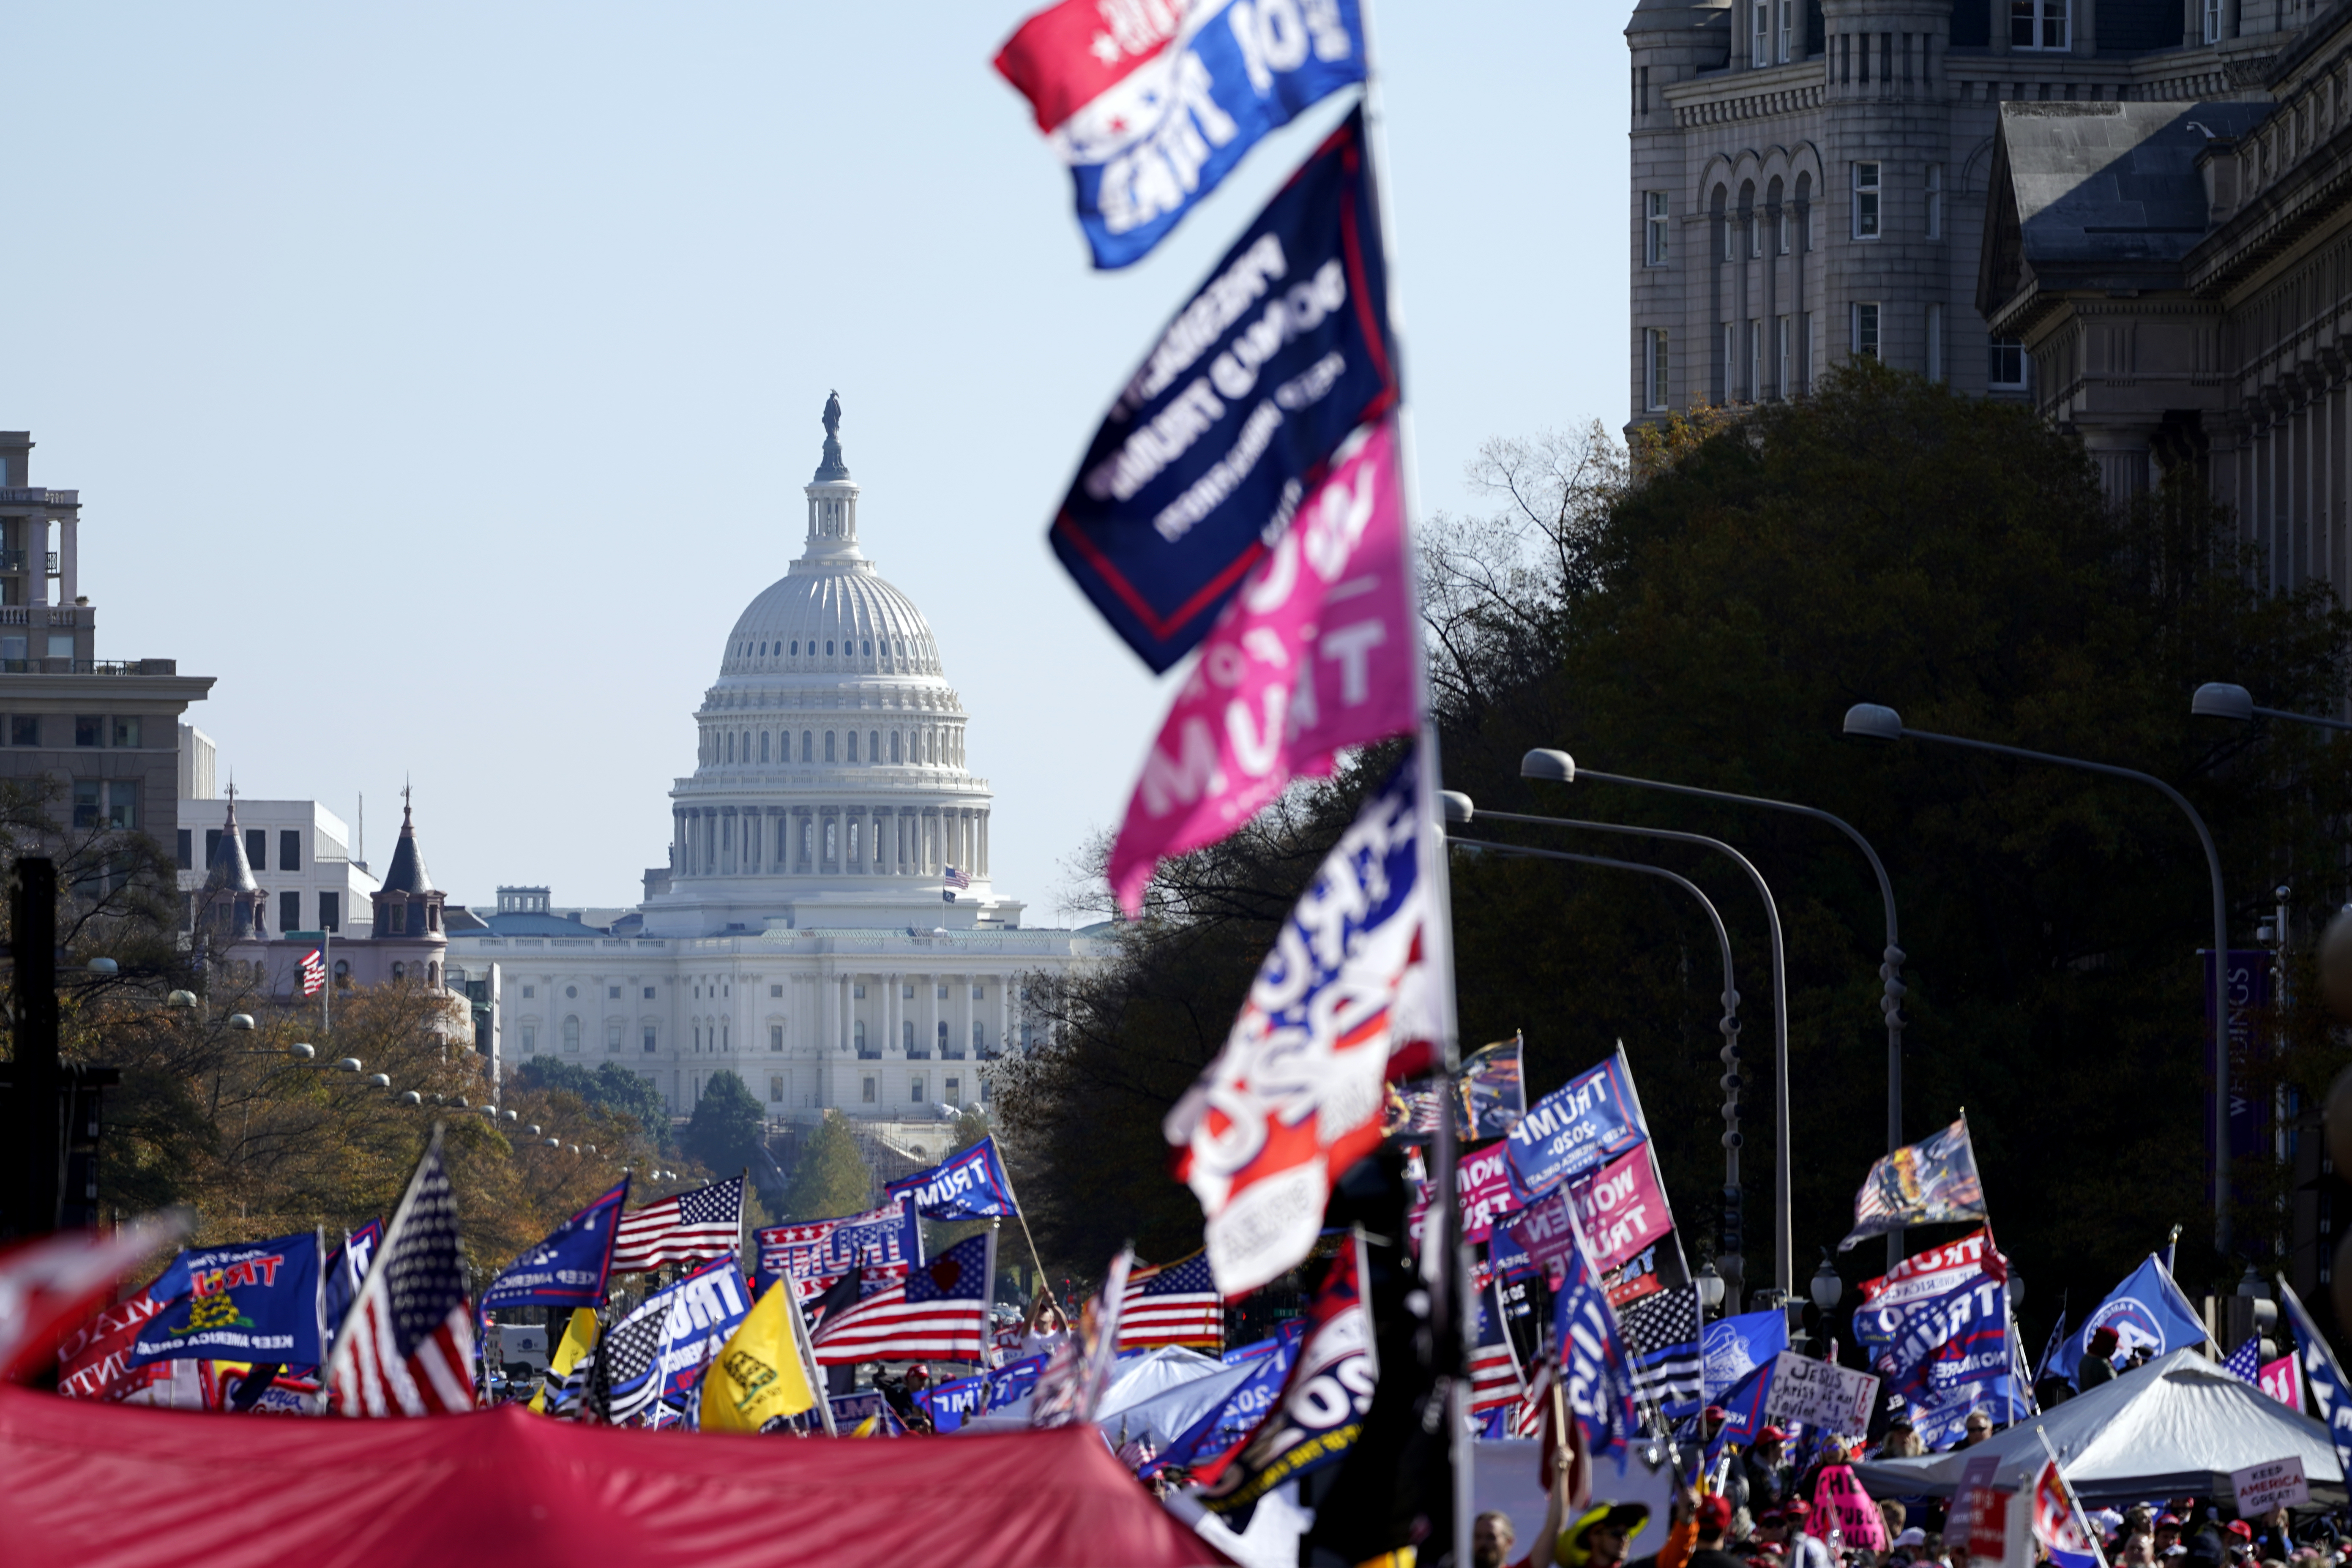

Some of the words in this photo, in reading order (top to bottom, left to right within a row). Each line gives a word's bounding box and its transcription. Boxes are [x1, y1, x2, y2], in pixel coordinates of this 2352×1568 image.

[2227, 967, 2249, 1118] WEDINGS
[1790, 1359, 1844, 1389] JESUS
[2240, 1474, 2303, 1498] AMERICA
[2251, 1464, 2283, 1481] KEEP
